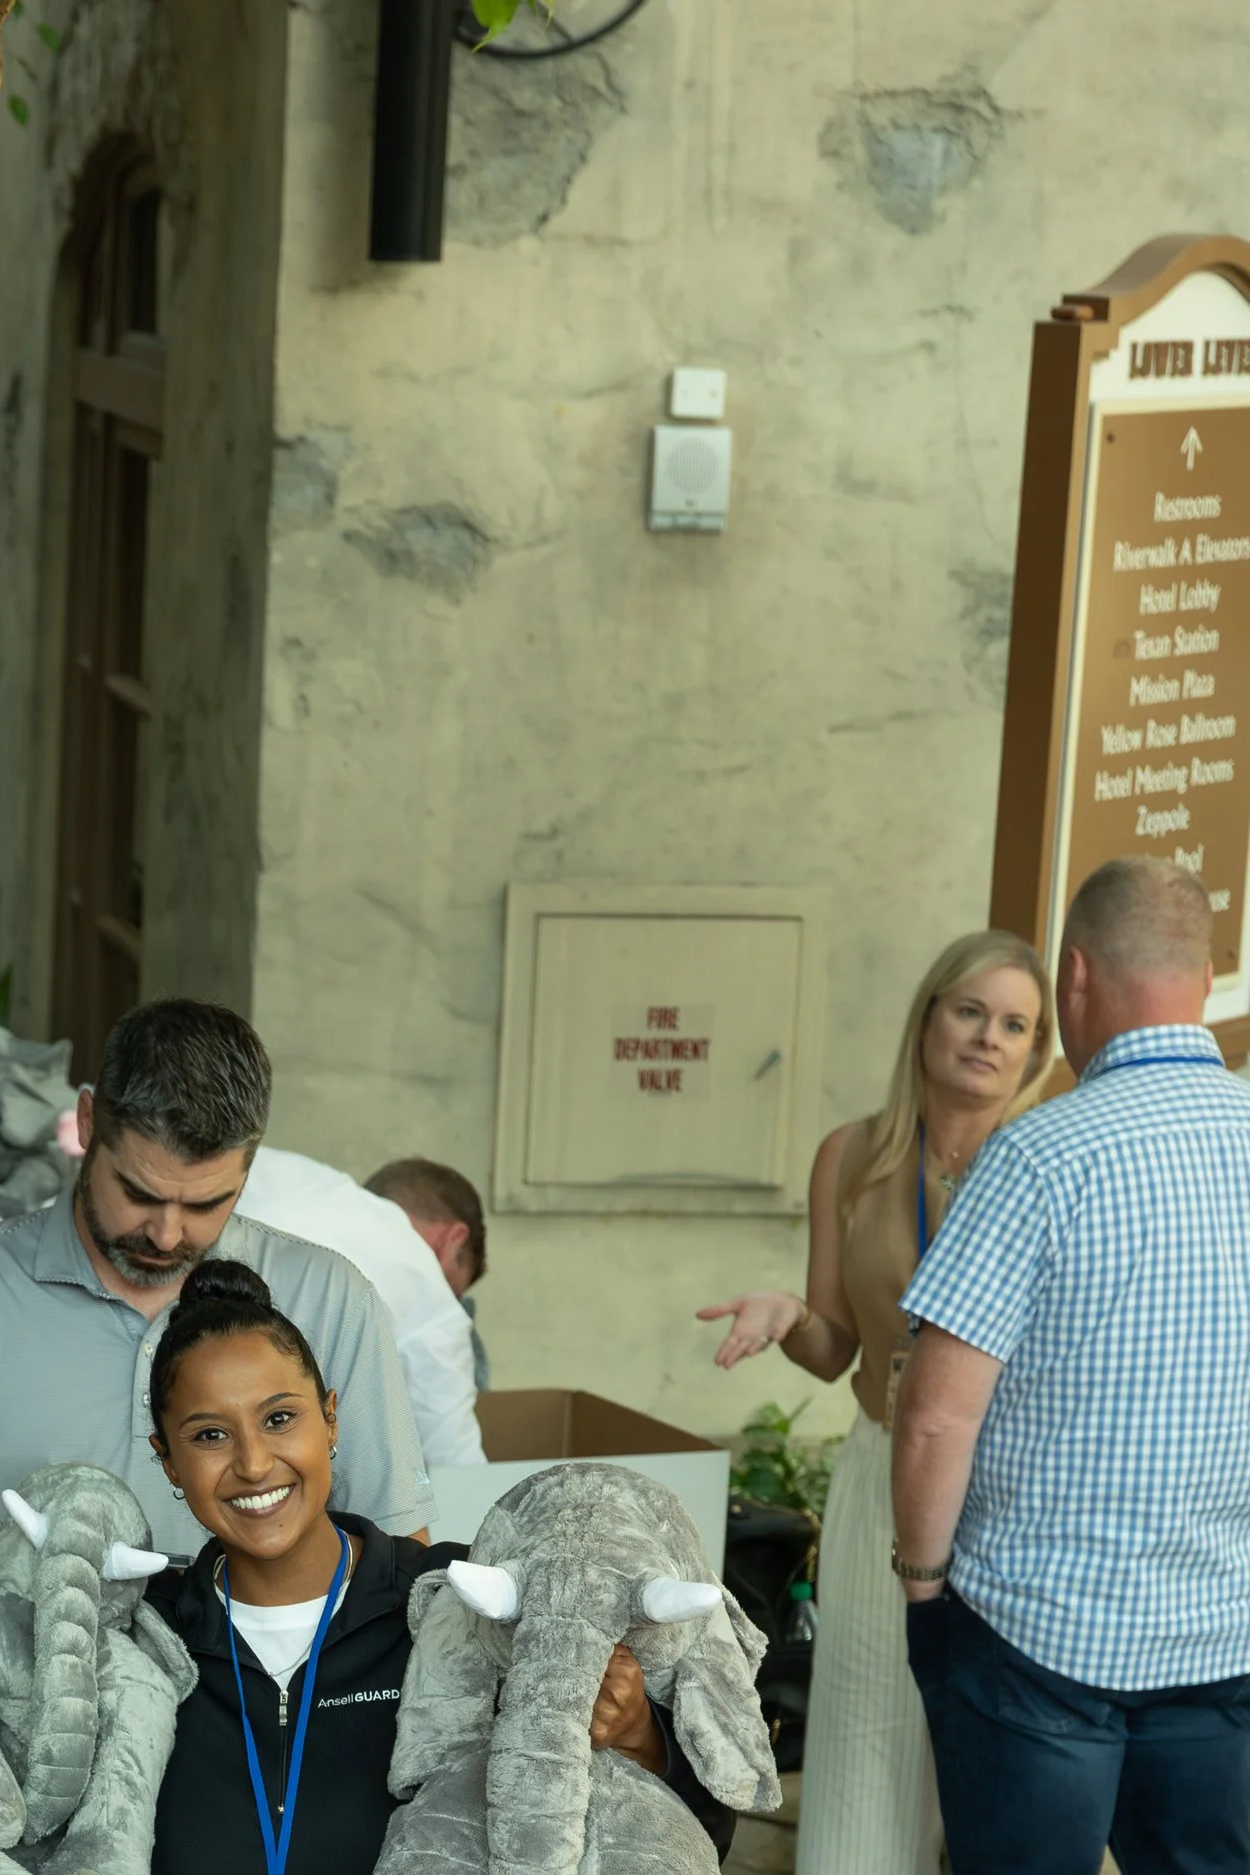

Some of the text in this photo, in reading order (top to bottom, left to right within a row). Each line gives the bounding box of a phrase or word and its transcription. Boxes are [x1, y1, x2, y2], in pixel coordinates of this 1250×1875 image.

[1130, 341, 1194, 379] LOWER
[1154, 491, 1221, 522] Restrooms
[1113, 536, 1177, 572] Riverwalk
[1178, 536, 1193, 566] A
[1139, 578, 1221, 615] Hotel Lobby
[1173, 624, 1219, 657] Station
[1129, 669, 1215, 707] Mission Plaza
[1101, 713, 1236, 755] Yellow Rose Ballroom
[1094, 756, 1235, 801] Hotel Meeting Rooms
[1135, 802, 1190, 839] Zeppole
[646, 1007, 680, 1030] FIRE
[614, 1038, 709, 1062] DEPARTMENT
[637, 1069, 683, 1092] VALVE
[317, 1689, 400, 1708] AnsellGUARD
